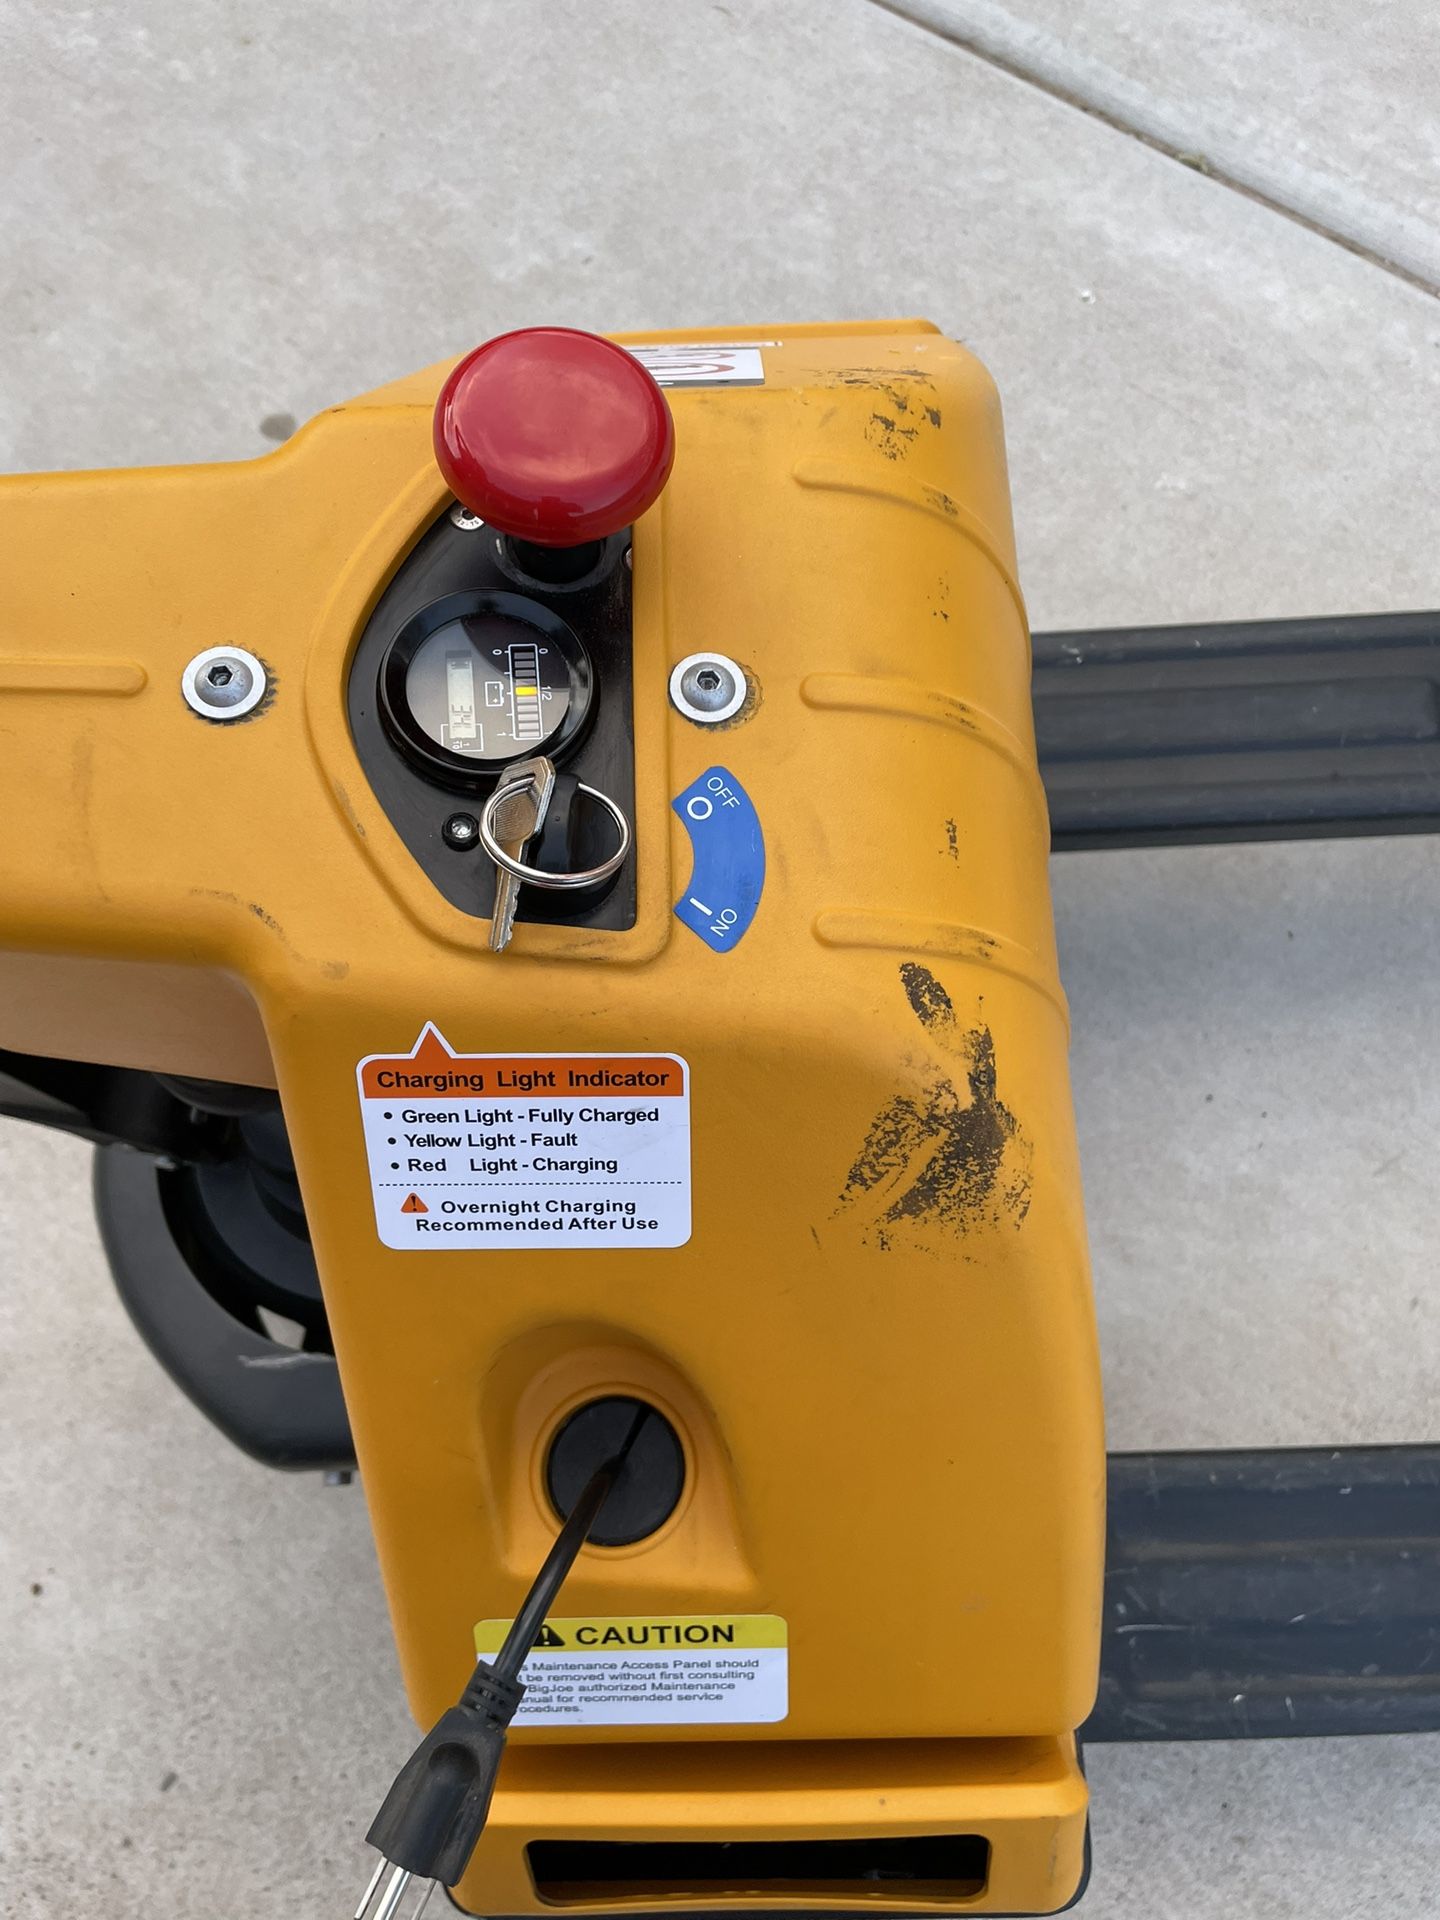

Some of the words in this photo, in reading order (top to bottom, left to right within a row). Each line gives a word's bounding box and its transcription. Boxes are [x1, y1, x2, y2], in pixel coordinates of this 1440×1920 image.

[541, 686, 553, 701] 1/2
[707, 777, 741, 808] OFF
[710, 908, 738, 937] ON
[377, 1071, 484, 1091] Charging
[497, 1070, 556, 1091] Light
[568, 1070, 670, 1087] Indicator
[402, 1109, 460, 1123] Green
[464, 1109, 514, 1126] Light
[528, 1108, 574, 1125] Fully
[579, 1108, 660, 1125] Charged
[404, 1133, 462, 1147] Yellow
[467, 1133, 516, 1150] Light
[531, 1133, 578, 1147] Fault
[407, 1158, 447, 1171] Red
[470, 1158, 518, 1175] Light
[532, 1157, 618, 1174] Charging
[441, 1200, 541, 1216] Overnight
[545, 1199, 637, 1215] Charging
[416, 1218, 564, 1231] Recommended
[568, 1217, 617, 1230] After
[622, 1217, 659, 1230] Use
[576, 1624, 734, 1645] CAUTION
[532, 1661, 618, 1671] Maintenance
[621, 1661, 669, 1670] Access
[673, 1660, 712, 1669] Panel
[715, 1659, 760, 1668] should
[526, 1674, 543, 1682] be
[547, 1672, 605, 1681] removed
[608, 1671, 656, 1681] without
[660, 1671, 684, 1680] first
[687, 1670, 755, 1680] consulting
[528, 1684, 574, 1694] BigJoe
[578, 1682, 647, 1692] authorized
[651, 1682, 736, 1691] Maintenance
[557, 1694, 575, 1702] for
[579, 1692, 673, 1702] recommended
[677, 1692, 724, 1701] service
[519, 1704, 584, 1713] ocedures.
